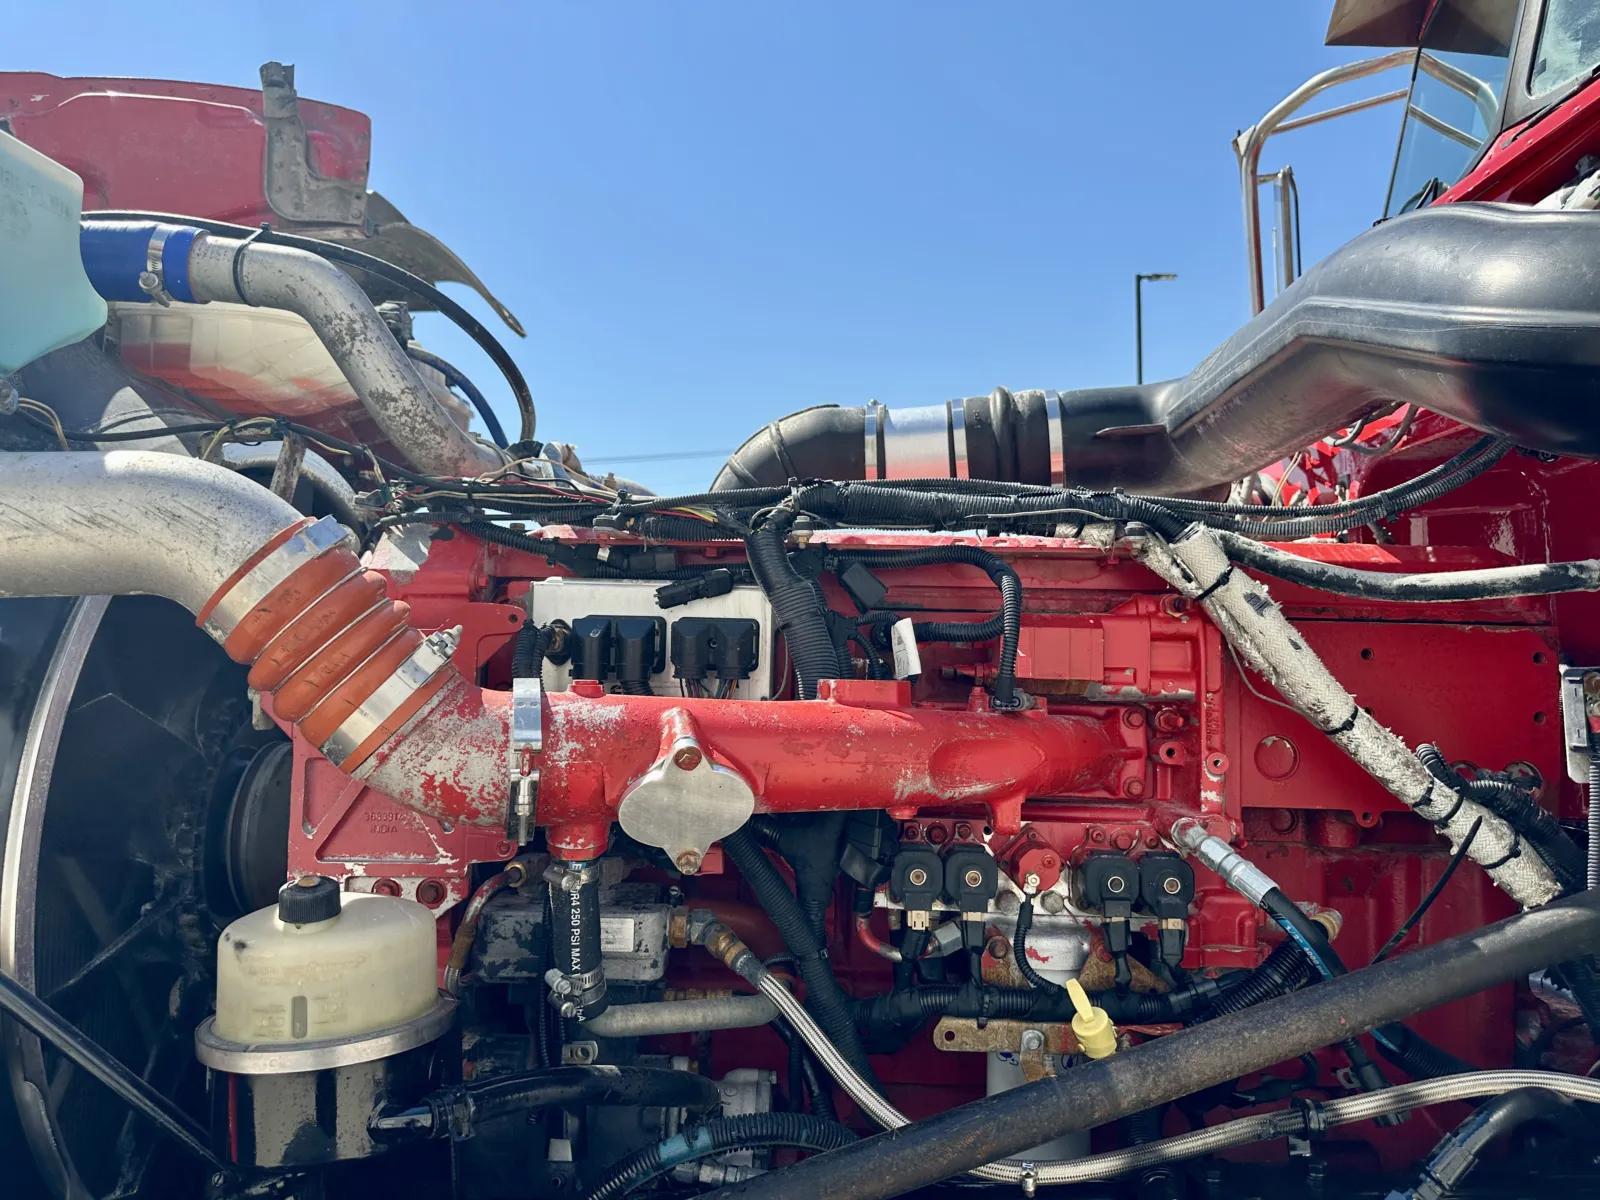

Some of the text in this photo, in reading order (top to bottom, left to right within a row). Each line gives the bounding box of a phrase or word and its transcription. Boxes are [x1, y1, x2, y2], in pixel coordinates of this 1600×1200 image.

[571, 908, 581, 926] 250
[571, 928, 581, 946] PSI
[571, 947, 581, 971] MAX
[1303, 946, 1320, 965] 4000
